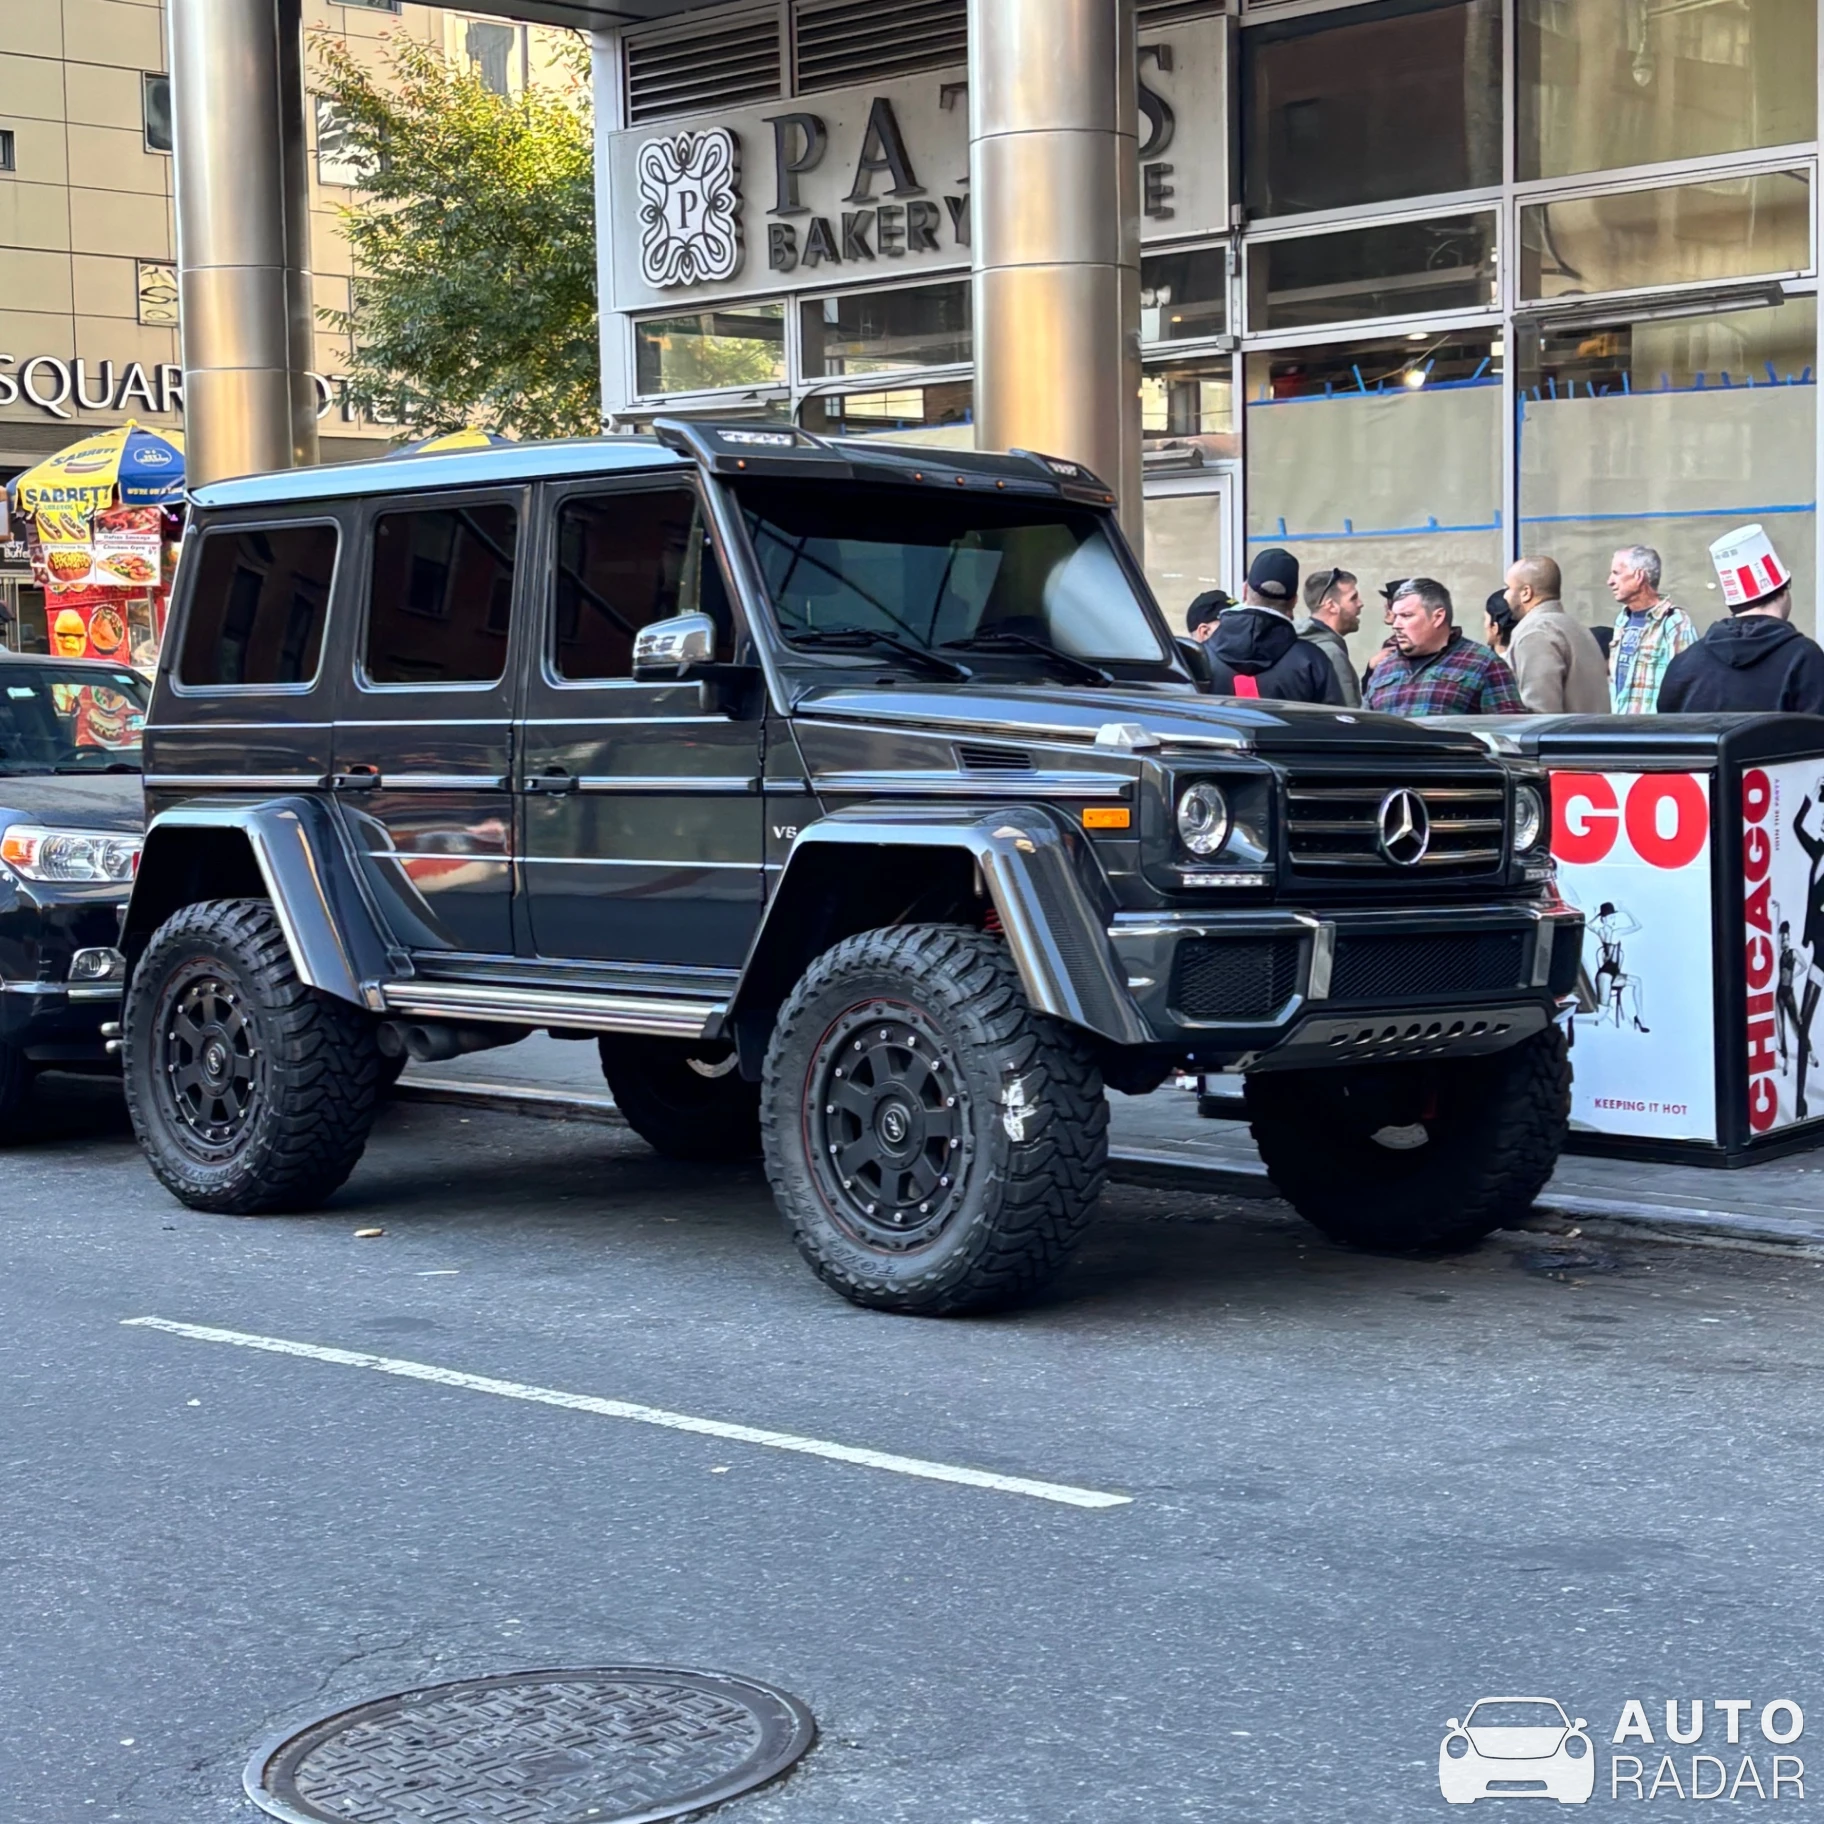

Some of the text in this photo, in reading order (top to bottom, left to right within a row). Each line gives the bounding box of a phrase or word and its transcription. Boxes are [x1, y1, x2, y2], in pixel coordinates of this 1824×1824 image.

[677, 189, 697, 229] P
[768, 192, 971, 273] BAKERY
[0, 353, 184, 419] SQUAR
[1743, 768, 1778, 1132] CHICAGO
[1594, 1098, 1688, 1115] KEEPING IT HOT
